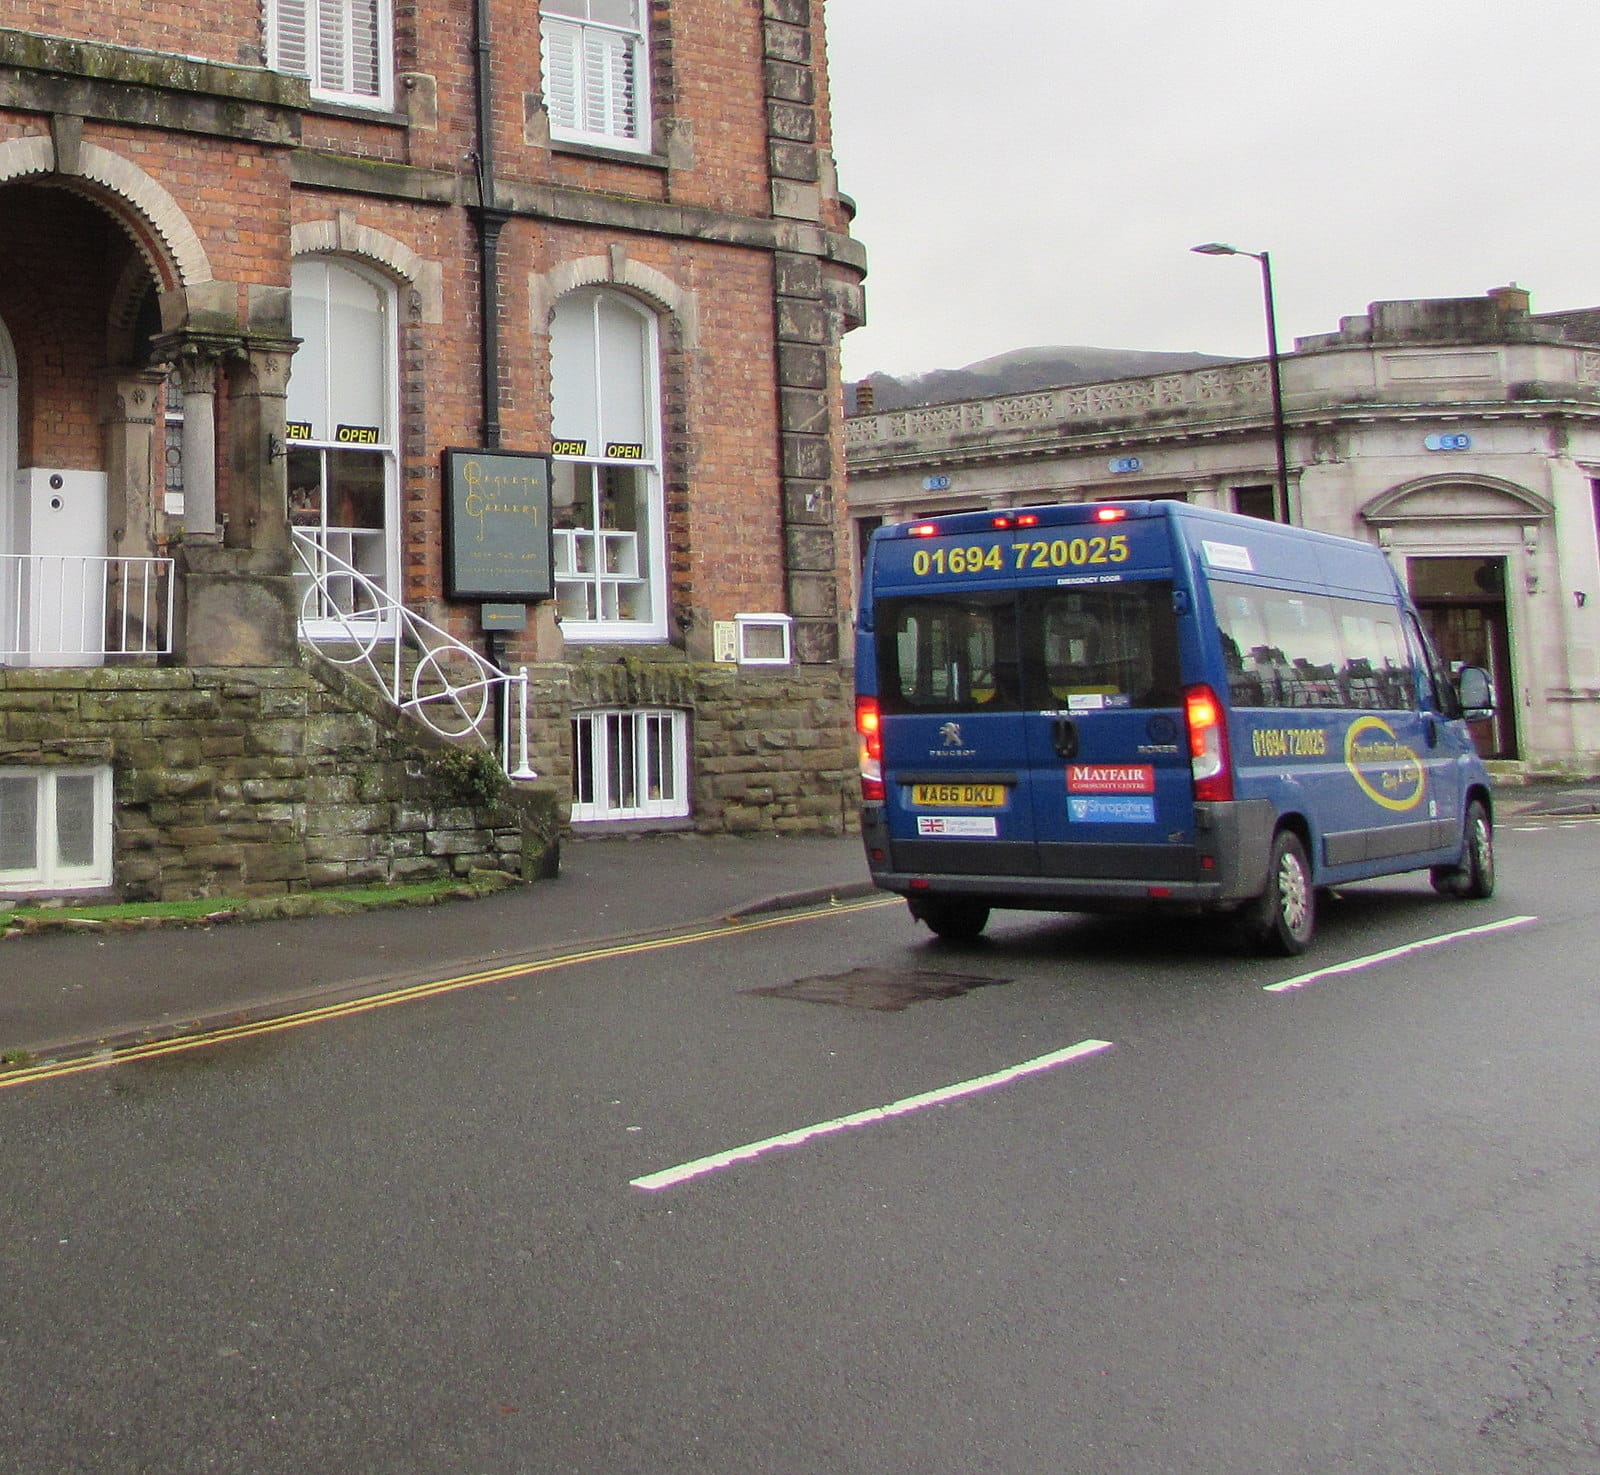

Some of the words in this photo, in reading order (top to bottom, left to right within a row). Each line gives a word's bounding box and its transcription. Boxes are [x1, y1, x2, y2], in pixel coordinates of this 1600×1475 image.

[286, 424, 309, 439] PEN
[339, 428, 377, 443] OPEN
[552, 441, 584, 455] OPEN
[607, 445, 640, 458] OPEN
[912, 544, 1003, 576] 01694
[1011, 534, 1129, 569] 720025
[1099, 574, 1121, 583] DOOR
[1252, 728, 1287, 757] 01694
[1287, 728, 1327, 756] 720025
[929, 749, 976, 757] PEUGEOT
[1072, 766, 1145, 781] MAYFAIR
[919, 786, 959, 802] WA66
